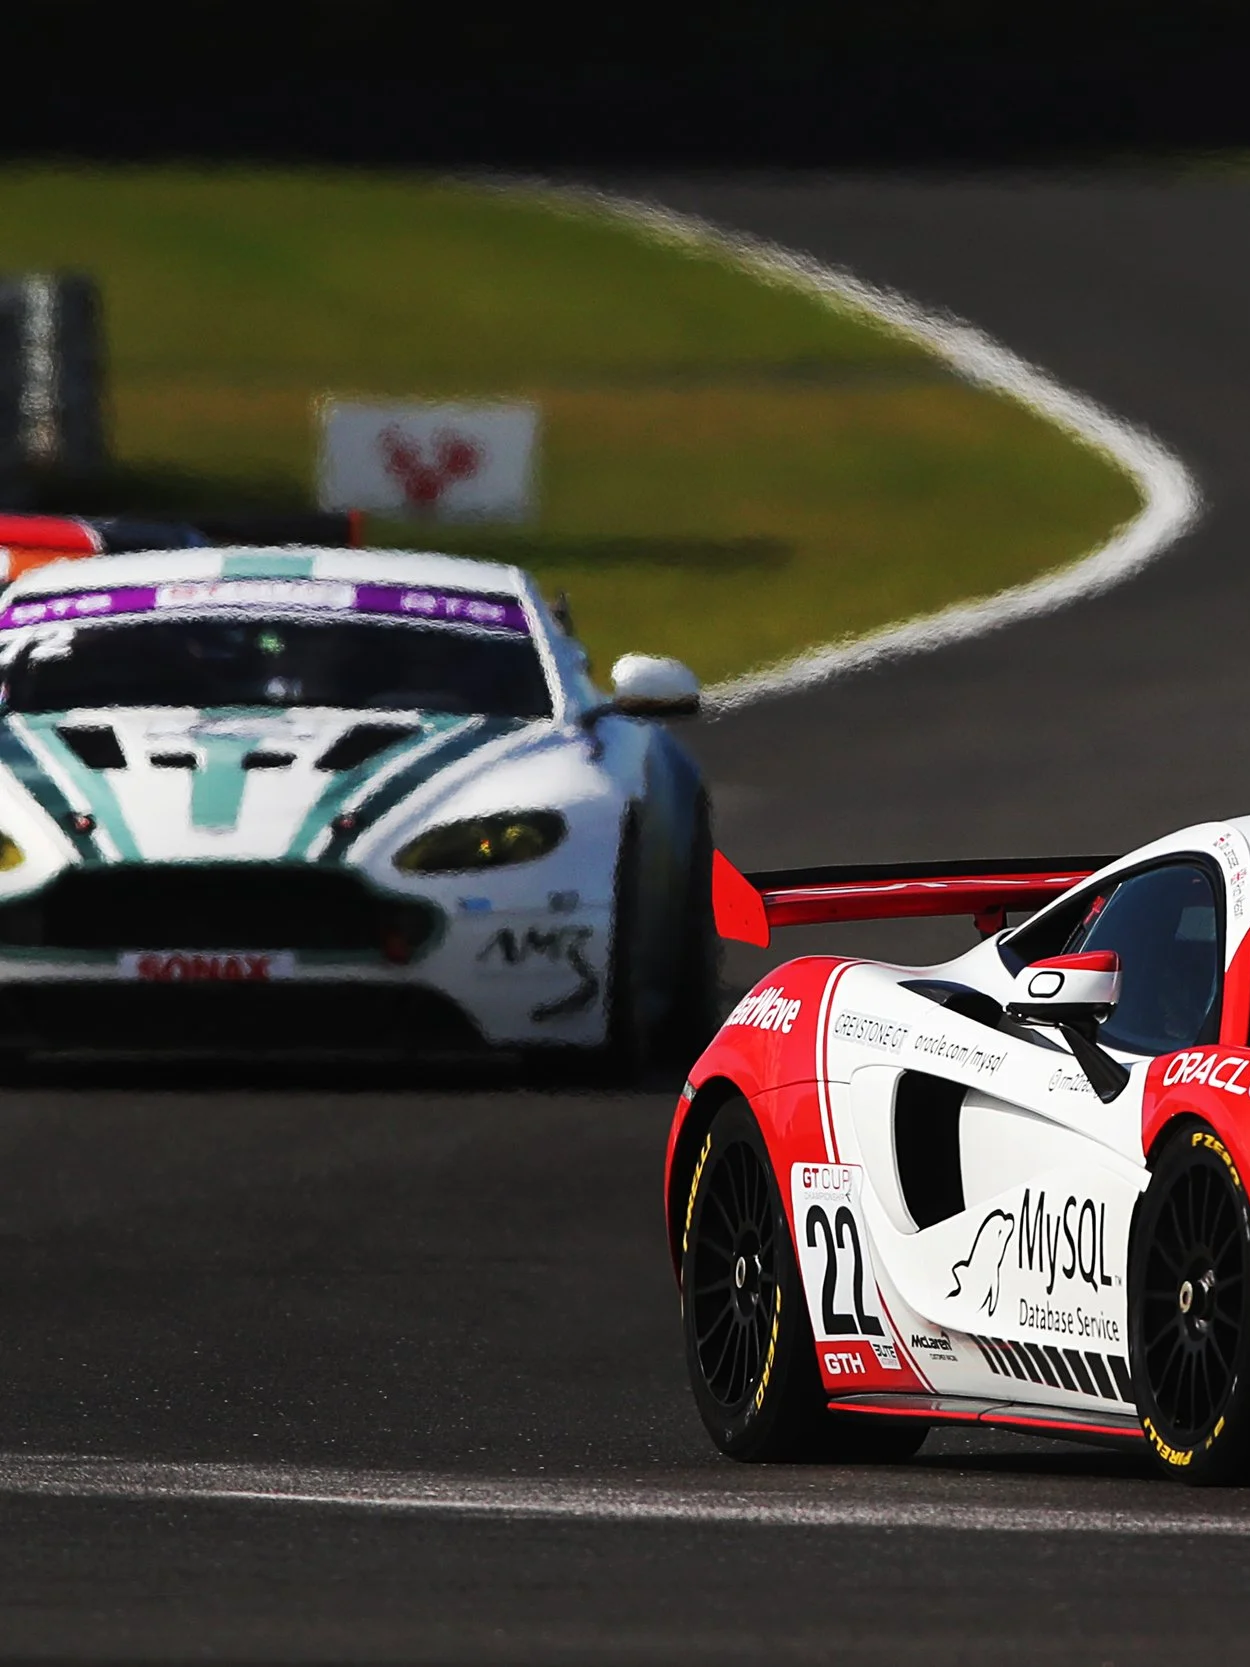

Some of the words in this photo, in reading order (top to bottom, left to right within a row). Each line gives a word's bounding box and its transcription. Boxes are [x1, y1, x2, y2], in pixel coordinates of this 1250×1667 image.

[914, 1034, 1008, 1077] oracle.com/mysql
[1018, 1188, 1112, 1295] MySQL
[806, 1204, 886, 1337] 22
[1019, 1298, 1074, 1335] Database
[1076, 1307, 1120, 1342] Service
[824, 1352, 866, 1375] GTH
[911, 1333, 953, 1351] McLaren
